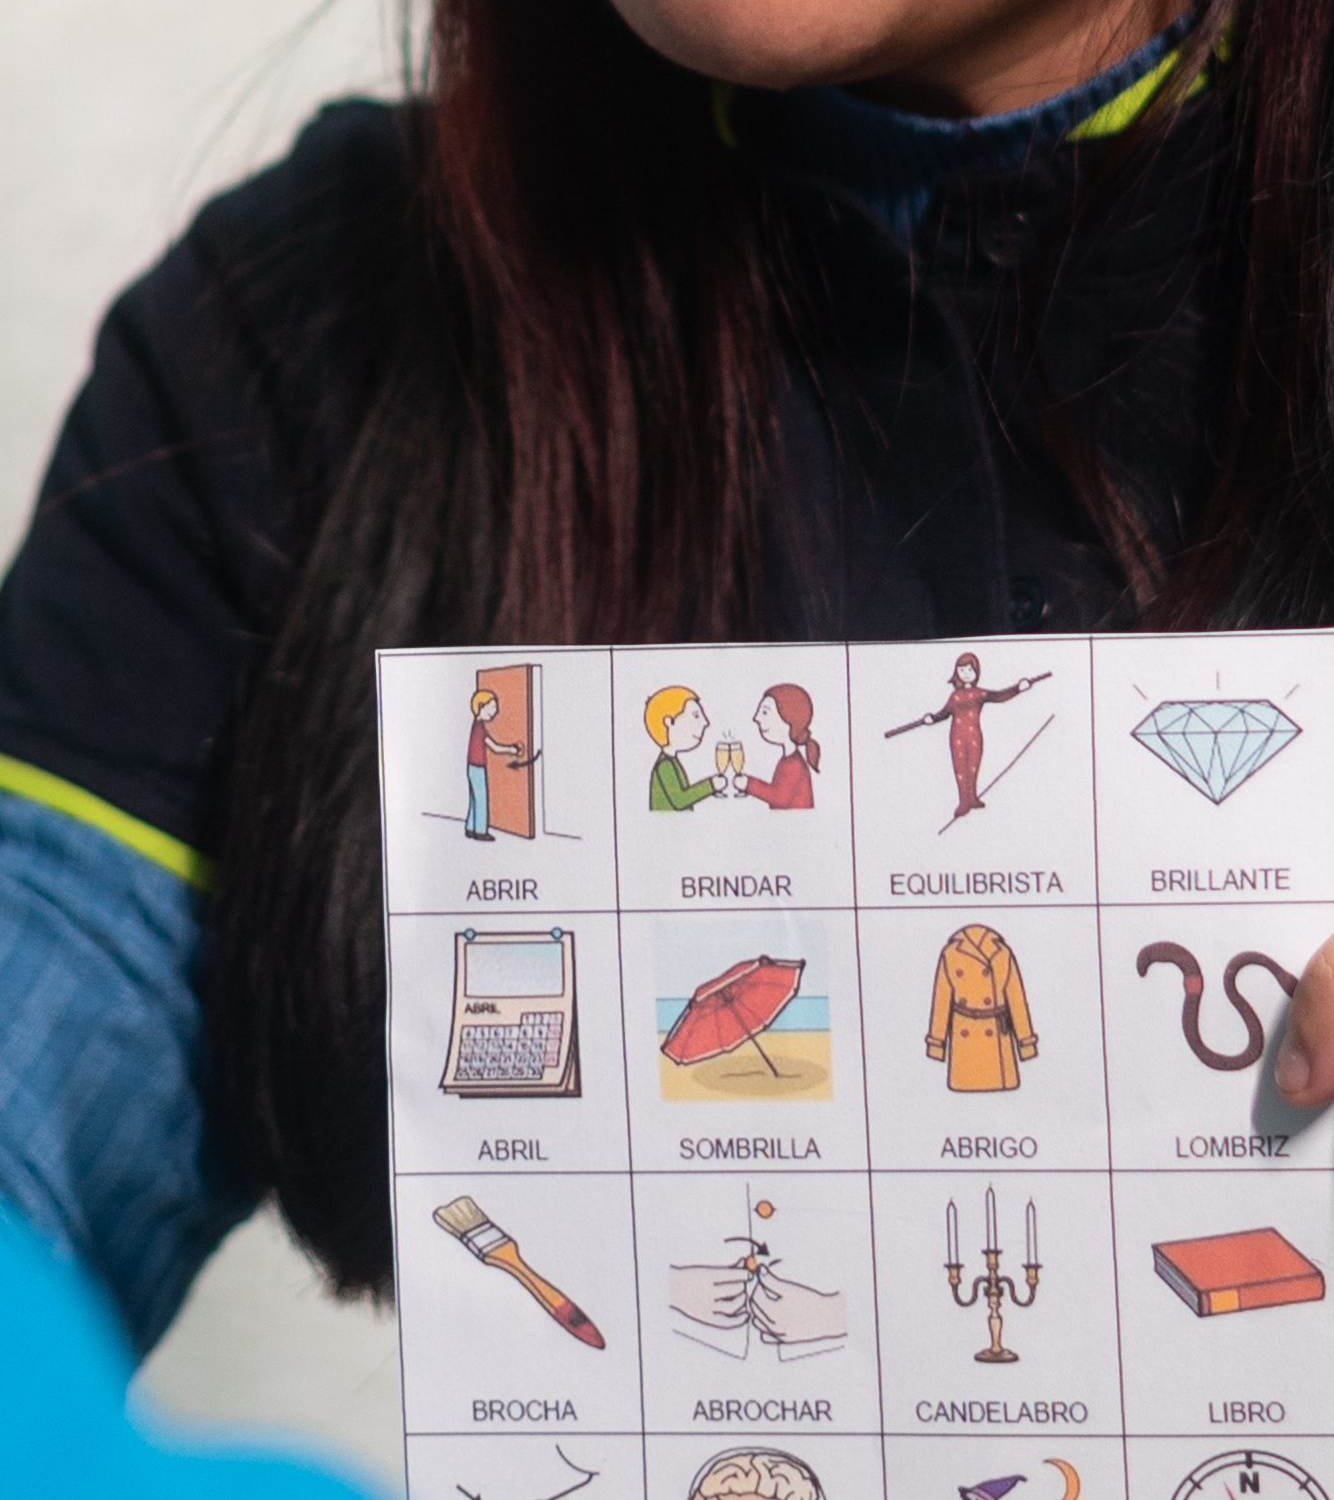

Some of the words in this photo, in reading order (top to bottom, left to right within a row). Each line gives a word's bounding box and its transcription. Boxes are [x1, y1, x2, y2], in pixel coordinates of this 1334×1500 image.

[466, 877, 539, 901] ABRIR
[680, 874, 793, 899] BRINDAR
[890, 870, 1065, 896] EQUILIBRISTA
[1150, 867, 1291, 892] BRILLANTE
[477, 1138, 549, 1161] ABRIL
[678, 1136, 822, 1160] SOMBRILLA
[940, 1135, 1039, 1159] ABRIGO
[1175, 1135, 1290, 1159] LOMBRIZ
[471, 1398, 578, 1422] BROCHA
[692, 1398, 833, 1422] ABROCHAR
[914, 1399, 1089, 1424] CANDELABRO
[1207, 1400, 1287, 1424] LIBRO
[1239, 1471, 1261, 1494] N
